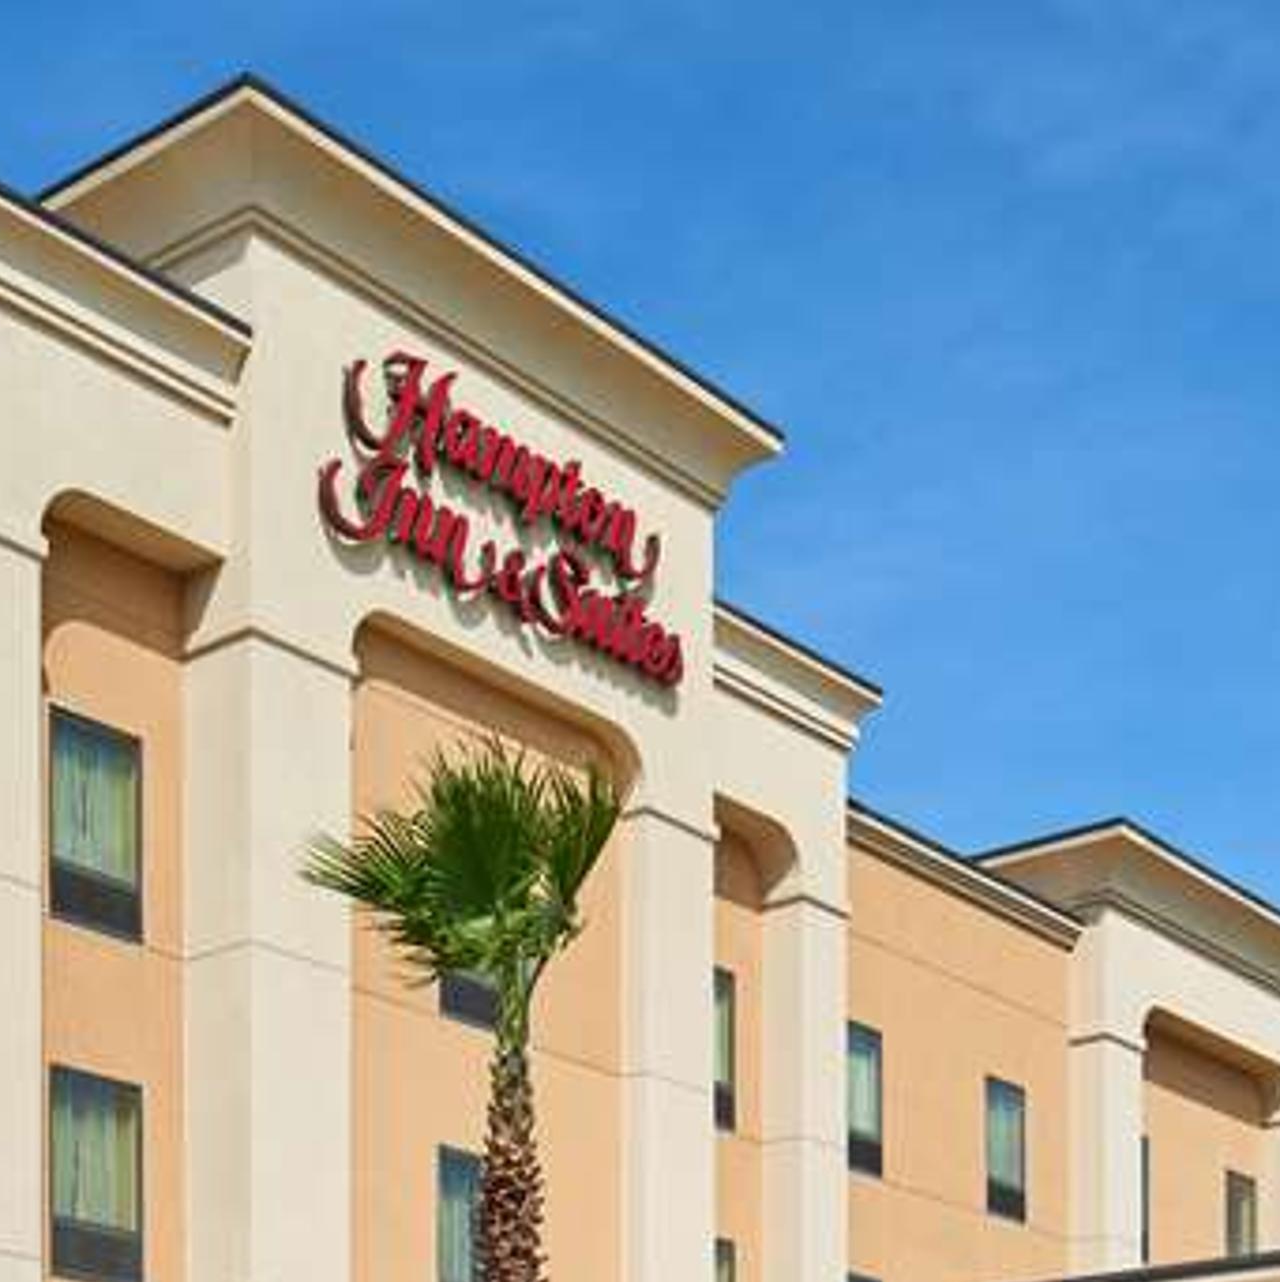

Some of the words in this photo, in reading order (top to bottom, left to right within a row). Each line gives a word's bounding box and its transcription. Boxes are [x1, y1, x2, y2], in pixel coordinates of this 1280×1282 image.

[318, 458, 496, 592] Inn
[529, 550, 683, 686] Suites
[343, 351, 661, 579] Hampton
